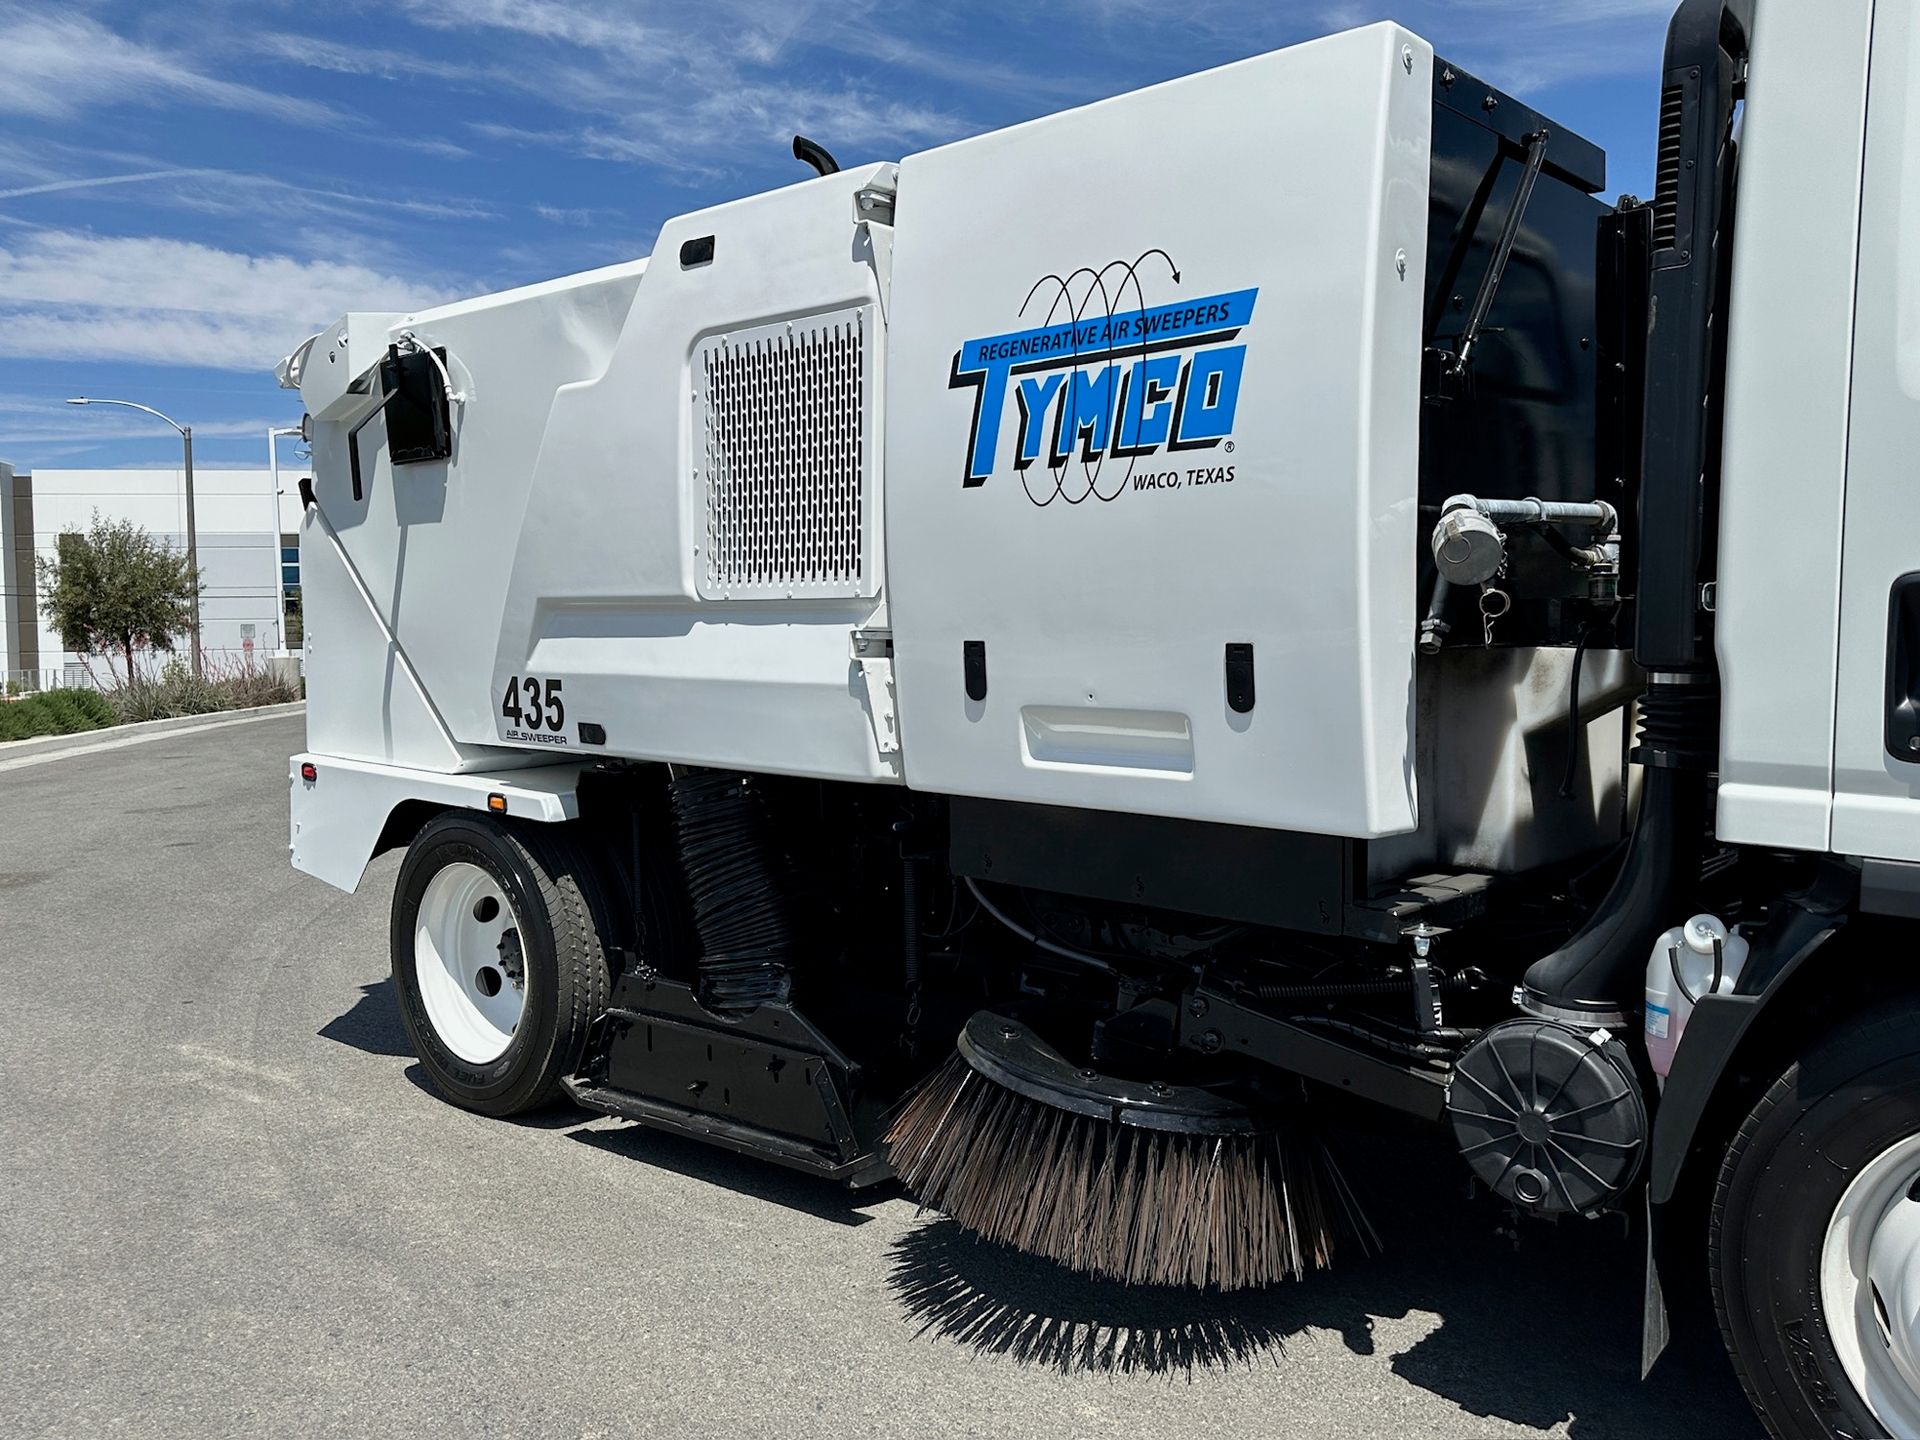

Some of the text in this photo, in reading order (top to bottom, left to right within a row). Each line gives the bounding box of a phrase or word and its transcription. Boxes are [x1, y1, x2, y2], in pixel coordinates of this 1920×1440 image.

[978, 302, 1230, 362] REGENERATIVE AIR SWEEPERS
[948, 288, 1258, 488] TYMCO
[1133, 466, 1235, 491] WACO, TEXAS
[502, 676, 564, 732] 435
[506, 729, 567, 744] AIR SWEEPER
